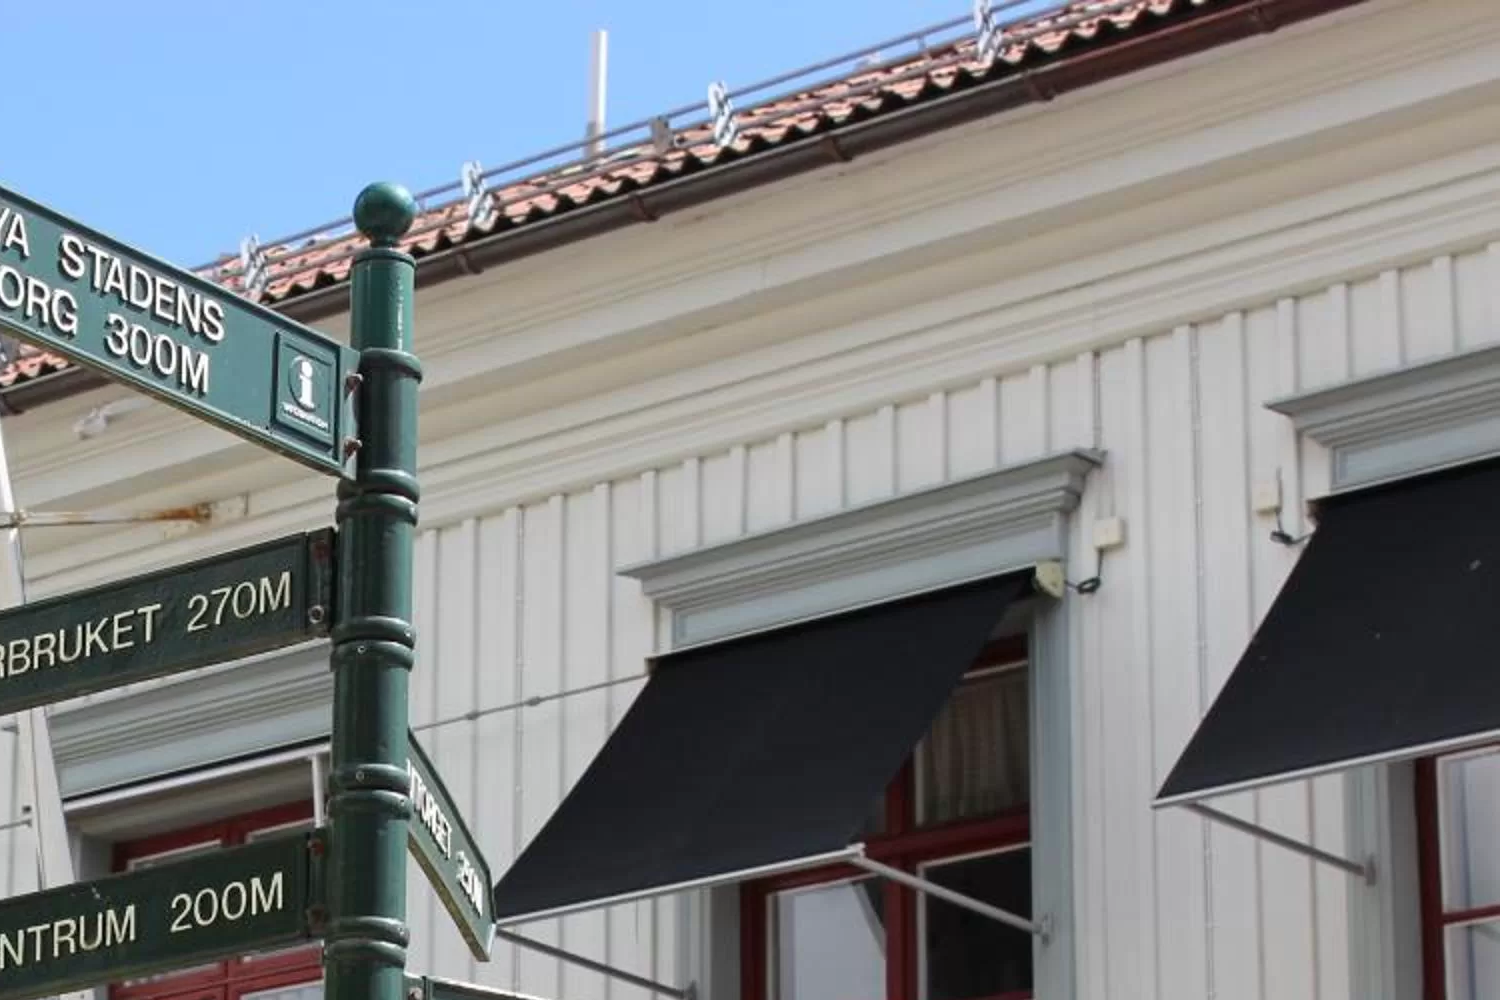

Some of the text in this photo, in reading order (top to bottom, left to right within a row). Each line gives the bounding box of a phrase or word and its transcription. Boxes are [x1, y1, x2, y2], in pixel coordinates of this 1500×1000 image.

[59, 232, 225, 343] STADENS
[104, 314, 209, 396] 300M
[186, 571, 291, 632] 270M
[170, 872, 284, 932] 200M
